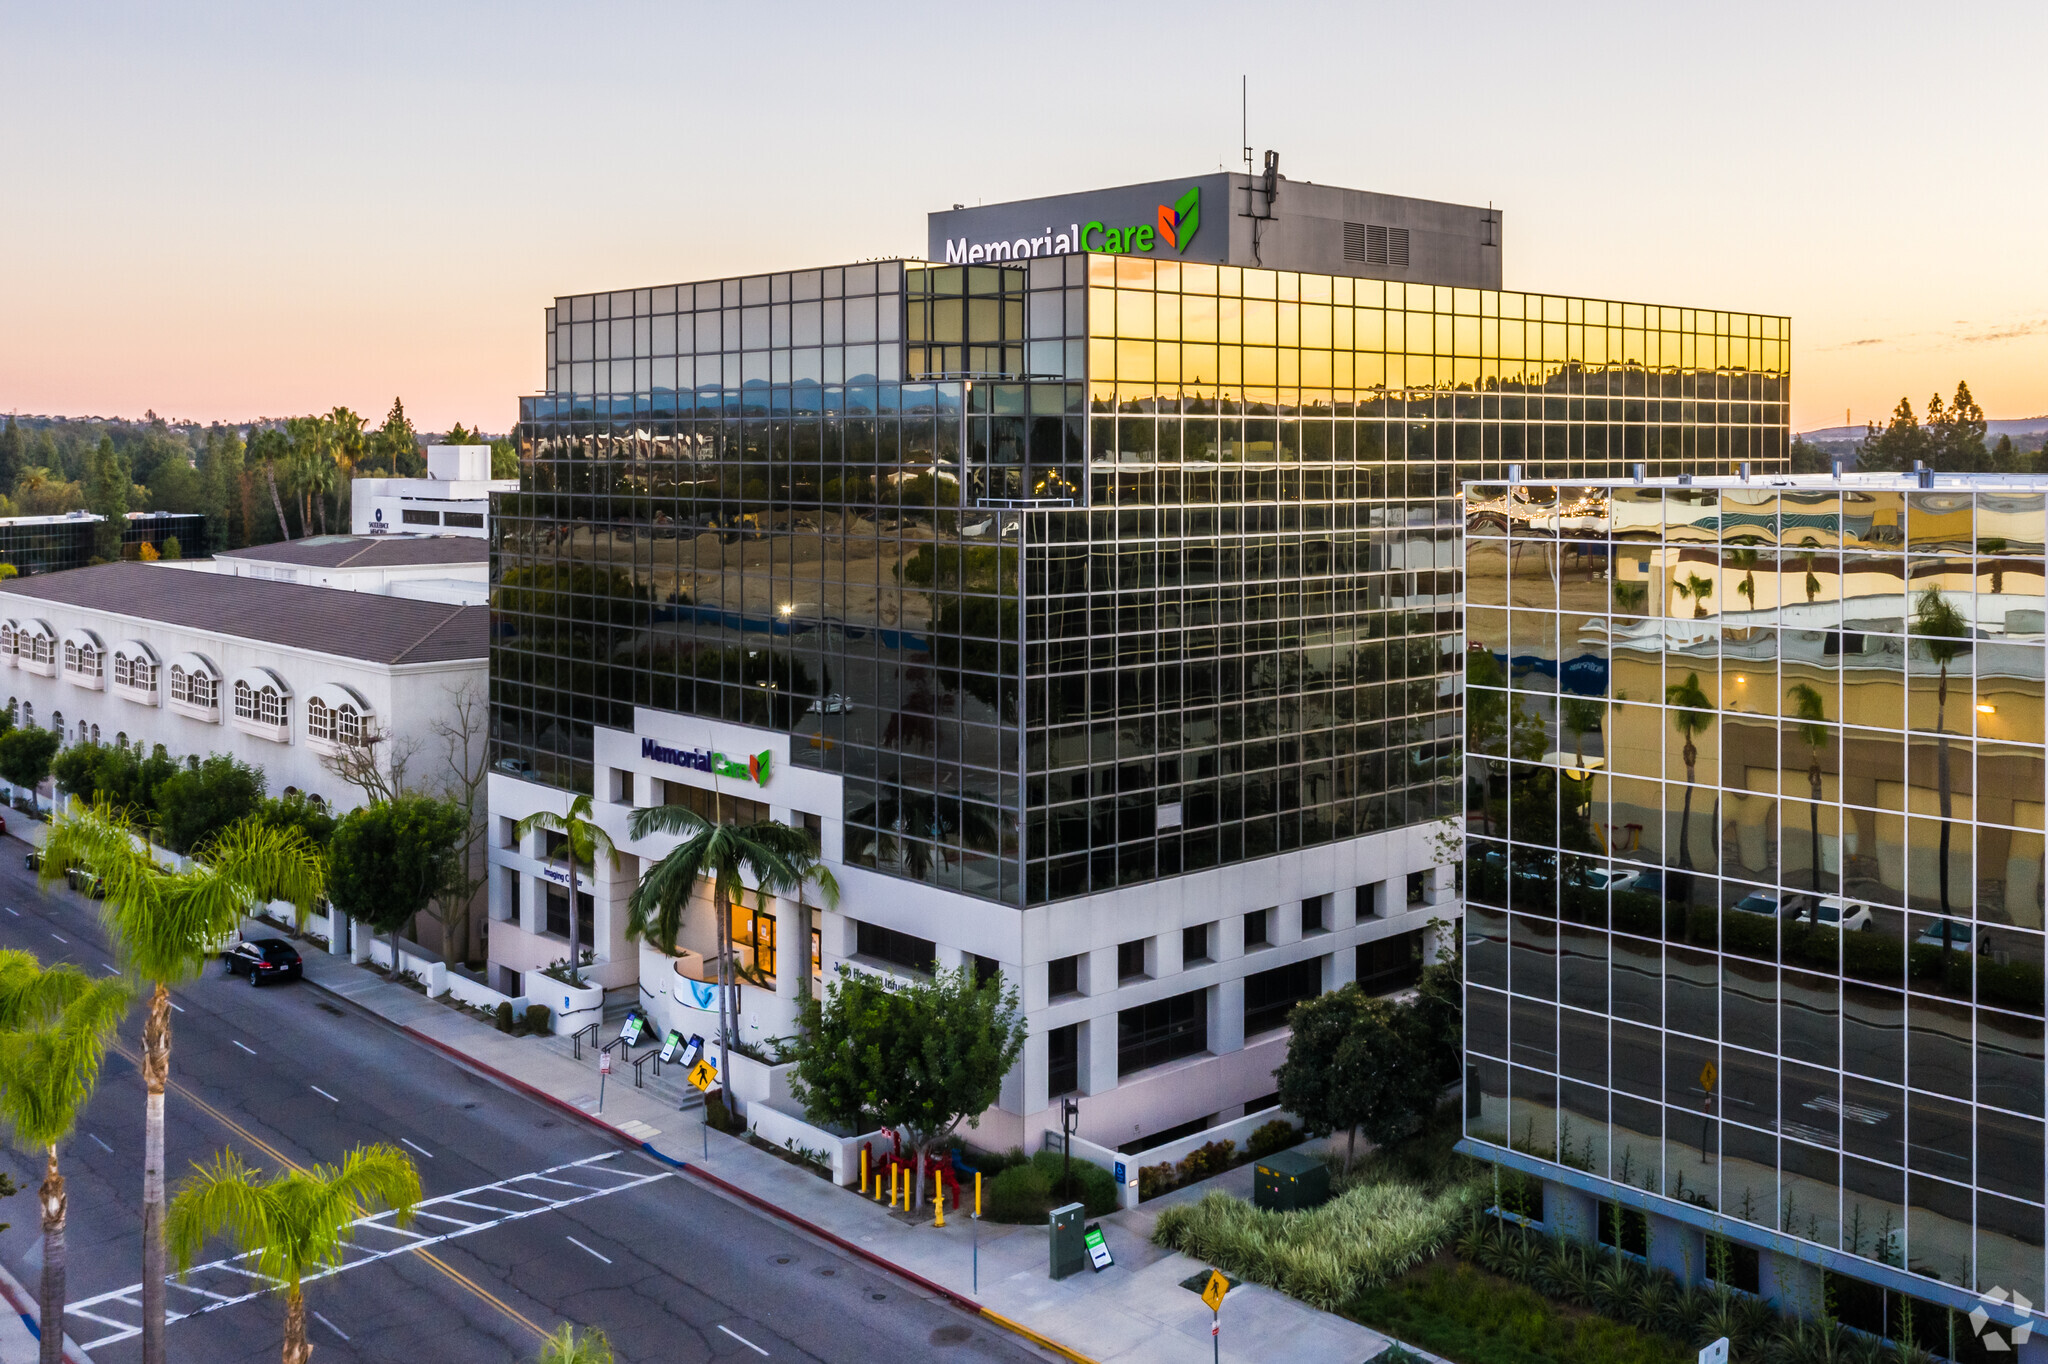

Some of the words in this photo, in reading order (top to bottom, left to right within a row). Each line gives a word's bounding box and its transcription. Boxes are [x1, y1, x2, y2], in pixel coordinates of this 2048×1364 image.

[945, 221, 1155, 263] MemorialCare
[641, 737, 751, 781] MemorialCare
[543, 867, 564, 883] Imaging
[565, 874, 583, 886] Cer
